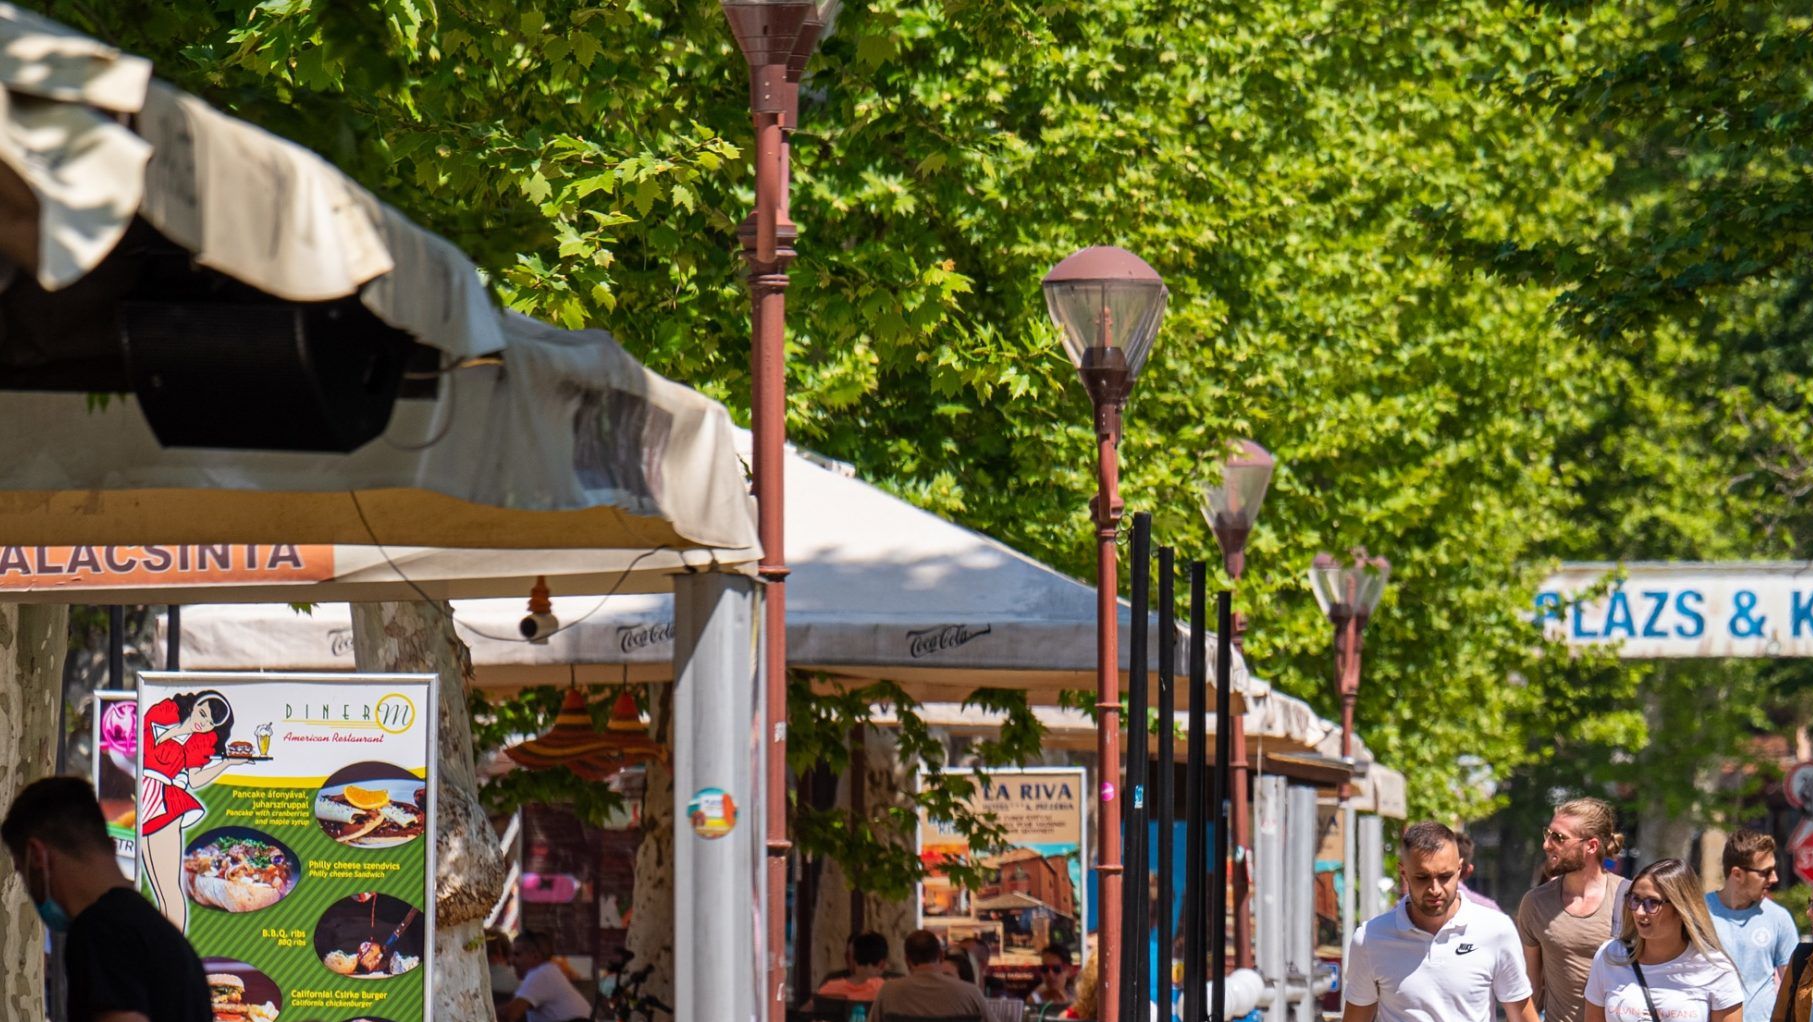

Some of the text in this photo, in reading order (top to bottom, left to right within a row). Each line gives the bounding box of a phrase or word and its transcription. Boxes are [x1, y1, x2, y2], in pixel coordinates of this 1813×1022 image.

[0, 545, 304, 576] ALACSINTA
[1533, 578, 1706, 638] PLÁZS
[1729, 589, 1766, 638] &
[285, 703, 371, 721] DINER
[283, 732, 384, 743] American Restaurant
[232, 790, 266, 799] Pancake
[983, 783, 1073, 800] LA RIVA
[226, 809, 310, 817] Pancake with cranberries
[291, 819, 310, 827] syrup
[118, 838, 134, 852] TR
[308, 860, 400, 871] Philly cheese szendvics
[308, 870, 385, 879] Philly cheese Sandwich
[291, 929, 306, 938] ribs
[334, 989, 359, 999] Csirke
[361, 990, 388, 1000] Burger
[291, 999, 324, 1007] California
